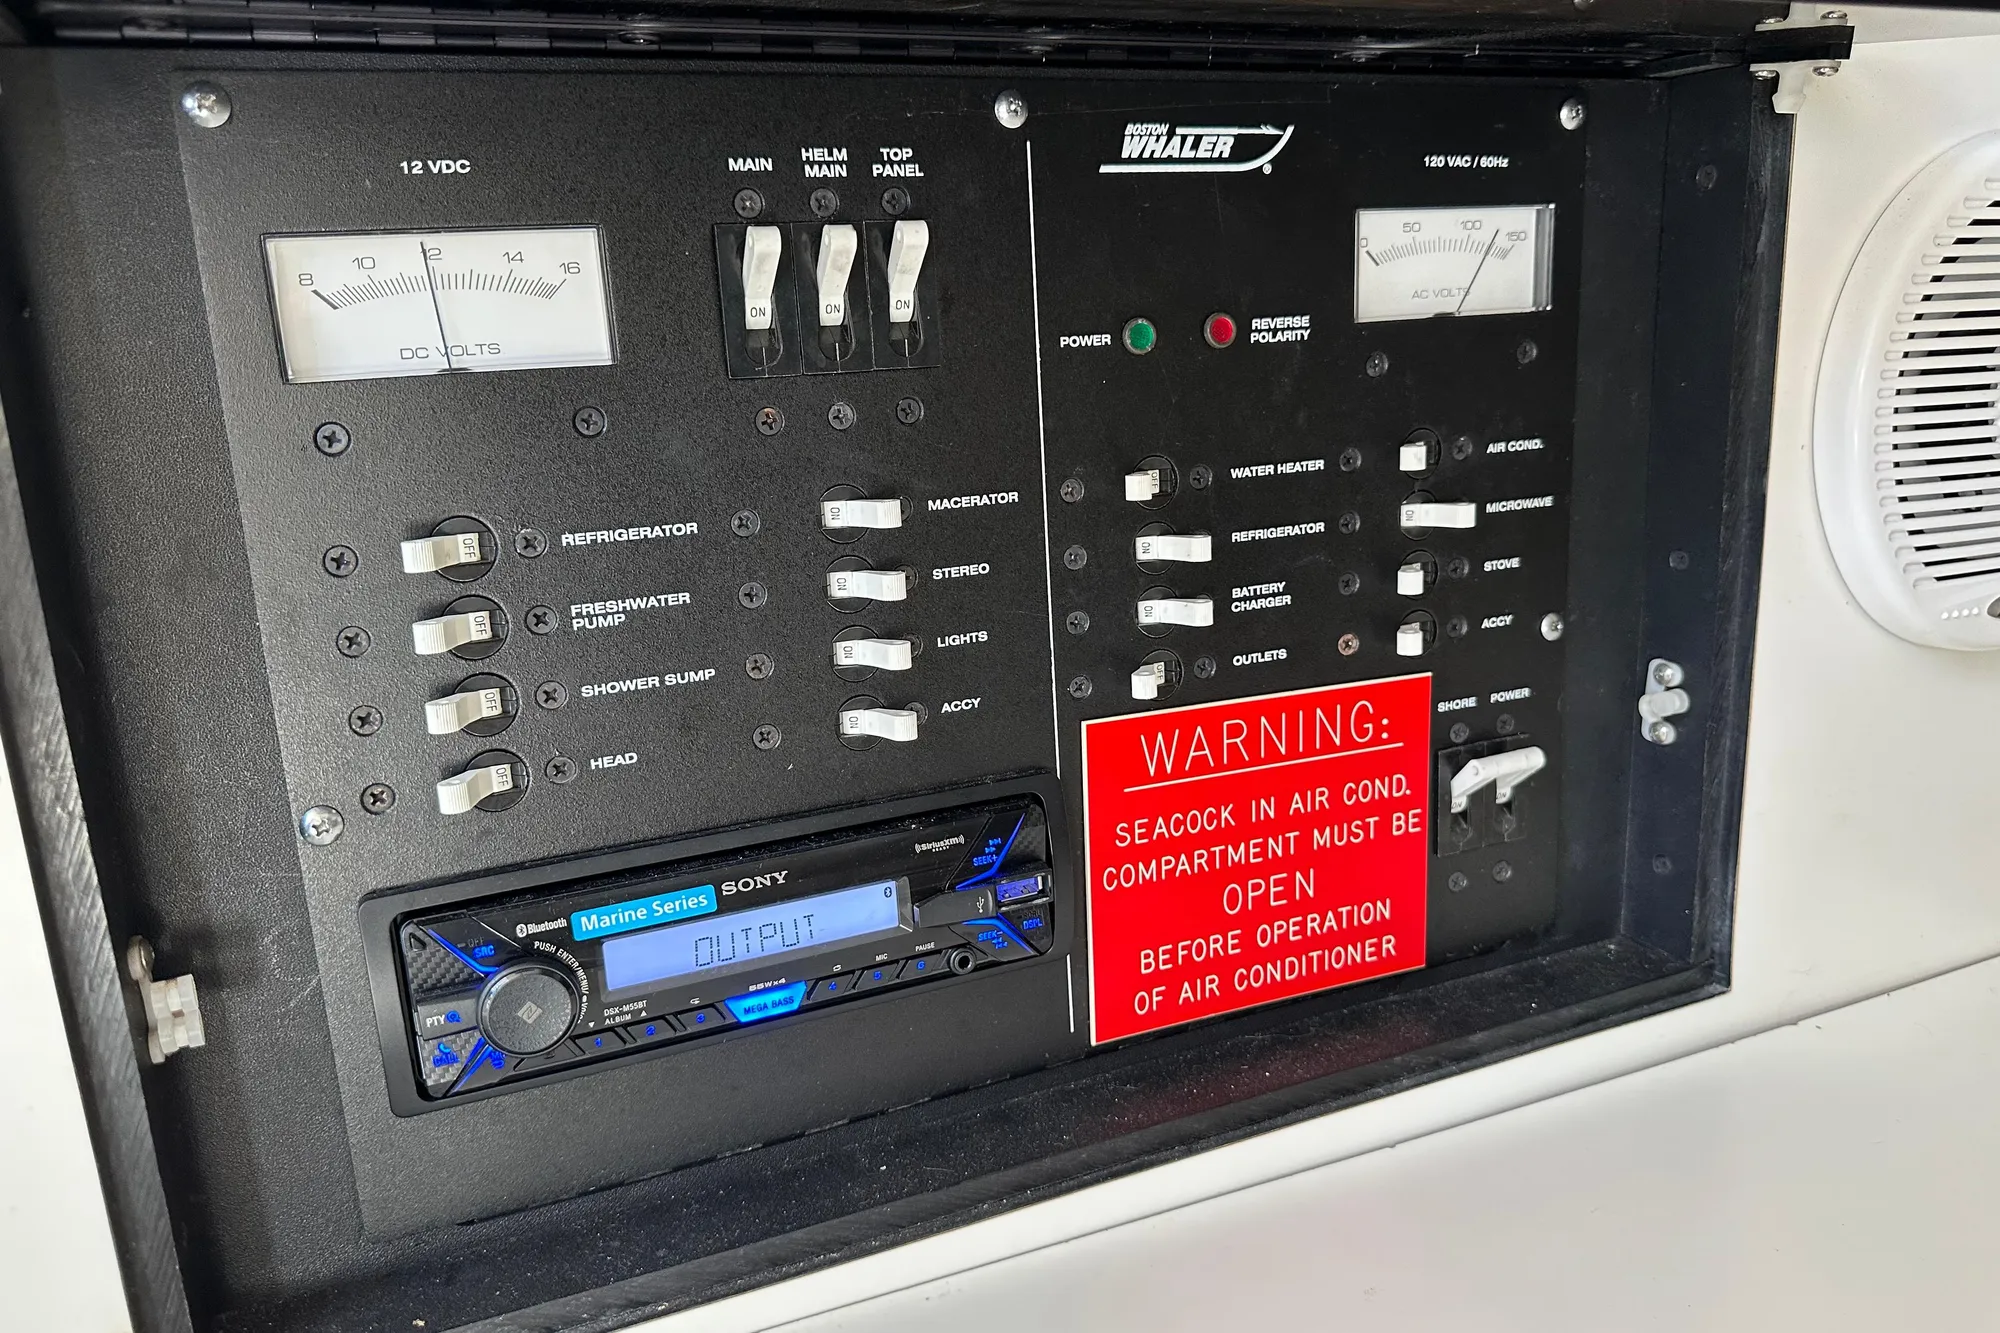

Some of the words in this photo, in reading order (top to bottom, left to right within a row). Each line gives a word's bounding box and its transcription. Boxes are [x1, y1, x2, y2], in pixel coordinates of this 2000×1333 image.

[1124, 122, 1169, 136] BOSTON
[801, 147, 848, 162] HELM
[879, 147, 913, 162] TOP
[1121, 135, 1235, 159] WHALER
[400, 160, 424, 175] 12
[428, 158, 472, 174] VDC
[728, 157, 773, 172] MAIN
[1423, 155, 1446, 168] 120
[1446, 155, 1472, 168] VAC
[1472, 155, 1479, 169] /
[1480, 156, 1510, 168] 60Hz
[804, 164, 848, 178] MAIN
[872, 163, 925, 178] PANEL
[1402, 222, 1422, 233] 50
[1460, 219, 1483, 231] 100
[1505, 230, 1528, 243] 150
[352, 256, 376, 270] 10
[502, 251, 525, 264] 14
[559, 261, 582, 275] 16
[298, 272, 315, 287] 8
[1411, 289, 1430, 301] AC
[1432, 287, 1472, 299] VOLTS
[750, 306, 767, 318] ON
[825, 303, 842, 315] ON
[895, 299, 911, 311] ON
[1251, 314, 1311, 331] REVERSE
[1060, 333, 1112, 348] POWER
[1250, 328, 1311, 344] POLARITY
[399, 347, 430, 361] DC
[435, 342, 502, 358] VOLTS
[1486, 440, 1506, 455] AIR
[1507, 437, 1545, 453] COND.
[1230, 463, 1275, 480] WATER
[1276, 459, 1325, 475] HEATER
[928, 490, 1020, 512] MACERATOR
[1485, 495, 1555, 514] MICROWAVE
[830, 506, 841, 521] ON
[1405, 508, 1415, 522] ON
[560, 521, 699, 548] REFRIGERATOR
[1231, 521, 1326, 544] REFRIGERATOR
[461, 536, 477, 560] OFF
[1141, 541, 1151, 554] ON
[932, 562, 991, 581] STEREO
[1483, 556, 1522, 572] STOVE
[836, 576, 847, 592] ON
[1232, 581, 1287, 600] BATTERY
[570, 592, 691, 617] FRESHWATER
[1143, 605, 1154, 618] ON
[1231, 594, 1293, 614] CHARGER
[472, 614, 488, 636] OFF
[572, 614, 627, 632] PUMP
[1481, 613, 1515, 630] ACCY
[936, 630, 989, 648] LIGHTS
[842, 645, 854, 659] ON
[1232, 648, 1288, 667] OUTLETS
[1155, 663, 1165, 680] OFF
[581, 675, 661, 699] SHOWER
[664, 667, 717, 687] SUMP
[483, 690, 498, 713] OFF
[940, 697, 982, 714] ACCY
[1437, 696, 1479, 713] SHORE
[1489, 686, 1532, 704] POWER
[848, 715, 860, 730] ON
[1140, 699, 1390, 778] WARNING:
[590, 752, 639, 770] HEAD
[495, 766, 510, 789] OFF
[1496, 791, 1508, 801] ON
[1115, 802, 1237, 848] SEACOCK
[1251, 795, 1276, 823] IN
[1289, 786, 1330, 817] AIR
[1342, 772, 1413, 806] COND.
[1451, 800, 1463, 810] ON
[1102, 830, 1301, 892] COMPARTMENT
[1312, 816, 1381, 851] MUST
[1391, 807, 1424, 836] BE
[972, 853, 999, 867] SEEK+
[720, 869, 790, 896] SONY
[1222, 867, 1316, 916] OPEN
[580, 907, 648, 933] Marine
[652, 893, 709, 917] Series
[526, 917, 568, 937] Bluetooth
[1022, 917, 1044, 931] DSPL
[694, 913, 815, 968] OUTPUT
[1139, 928, 1243, 976] BEFORE
[1255, 896, 1393, 949] OPERATION
[473, 943, 496, 959] SRC
[533, 940, 557, 954] PUSH
[915, 941, 936, 952] PAUSE
[875, 952, 889, 962] MIC
[916, 961, 926, 970] 6
[873, 970, 883, 981] 5
[1133, 985, 1168, 1016] OF
[1178, 973, 1221, 1006] AIR
[1233, 933, 1398, 993] CONDITIONER
[603, 999, 648, 1018] DSX-M55BT
[743, 1001, 770, 1016] MEGA
[771, 995, 795, 1010] BASS
[425, 1014, 446, 1029] PTY
[604, 1012, 633, 1027] ALBUM
